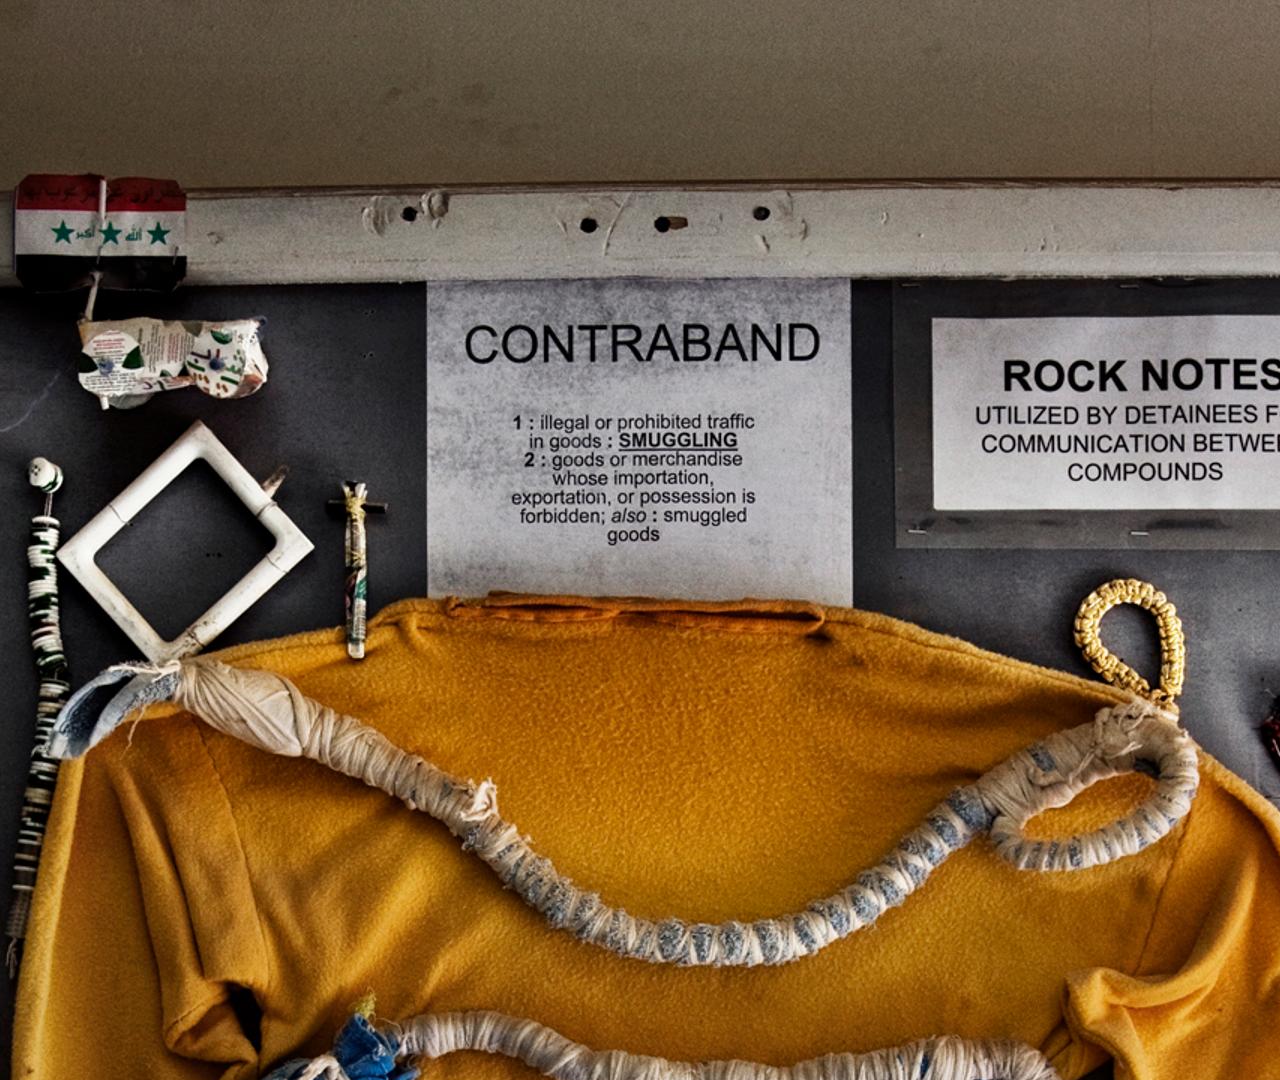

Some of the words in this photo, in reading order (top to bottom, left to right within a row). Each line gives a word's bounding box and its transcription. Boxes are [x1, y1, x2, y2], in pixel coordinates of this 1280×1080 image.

[125, 224, 142, 241] الله
[465, 322, 820, 365] CONTRABAND
[1003, 359, 1128, 393] ROCK
[513, 414, 521, 430] 1
[540, 414, 590, 433] illegal
[594, 417, 613, 430] or
[617, 413, 702, 433] prohibited
[706, 413, 755, 430] traffic
[975, 405, 1079, 425] UTILIZED
[1087, 405, 1118, 425] BY
[1125, 404, 1258, 425] DETAINEES
[529, 433, 544, 449] in
[549, 433, 602, 452] goods
[618, 433, 739, 450] SMUGGLING
[981, 433, 1185, 454] COMMUNICATION
[524, 451, 535, 468] 2
[551, 450, 605, 471] goods
[609, 454, 628, 467] or
[632, 450, 743, 467] merchandise
[551, 469, 609, 486] whose
[613, 469, 714, 489] importation,
[1067, 461, 1223, 482] COMPOUNDS
[511, 488, 611, 509] exportation,
[617, 492, 635, 505] or
[639, 488, 736, 508] possession
[742, 488, 756, 504] is
[519, 506, 605, 526] forbidden;
[610, 507, 647, 524] also
[663, 507, 747, 527] smuggled
[607, 526, 660, 546] goods
